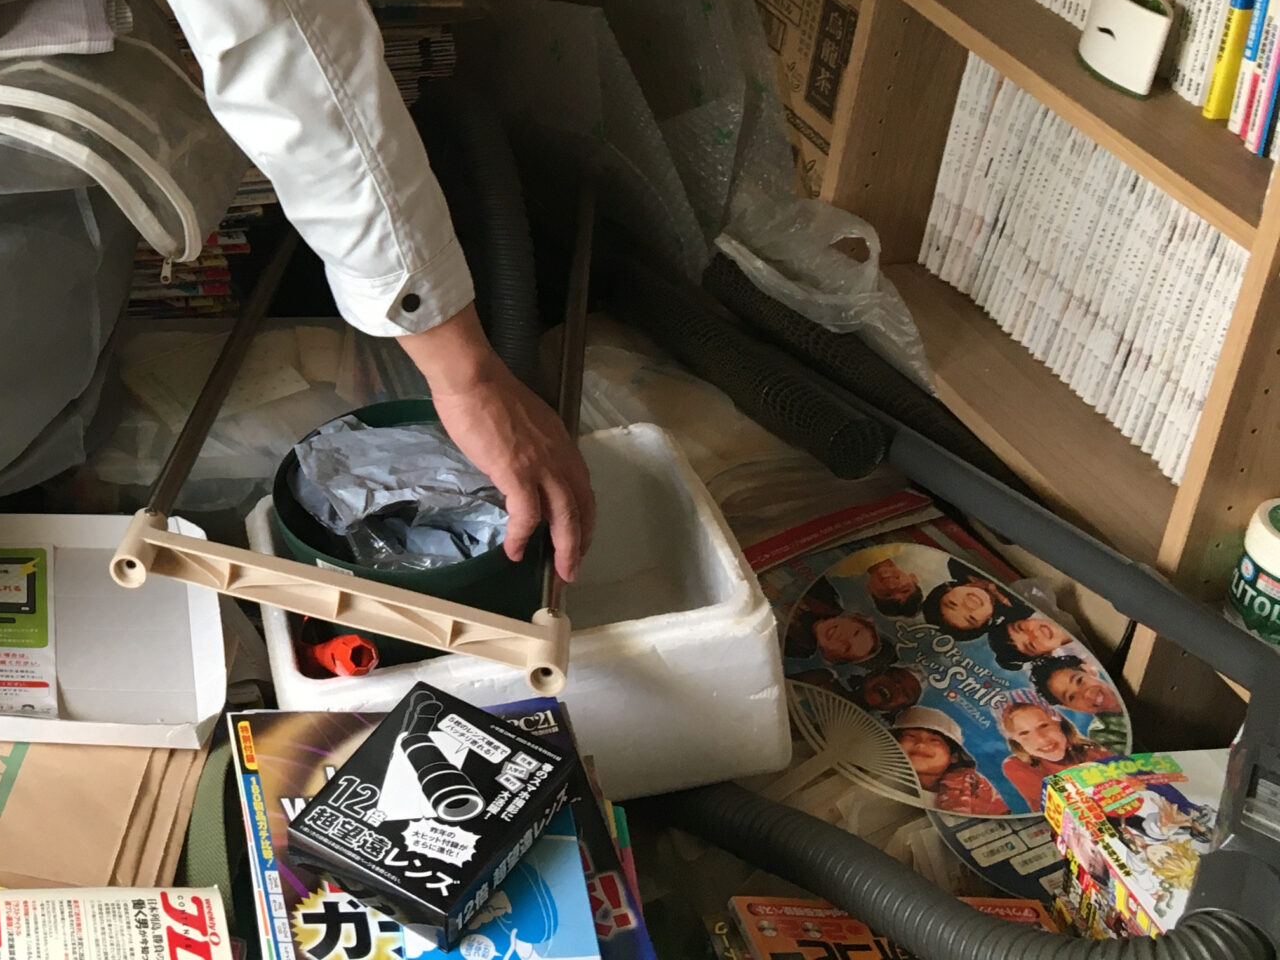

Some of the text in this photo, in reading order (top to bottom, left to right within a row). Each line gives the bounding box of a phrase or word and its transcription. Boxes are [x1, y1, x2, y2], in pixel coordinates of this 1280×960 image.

[813, 12, 845, 96] 烏龍茶
[928, 666, 1009, 709] Smile
[447, 716, 508, 756] 5枚のレンズ構成で
[501, 762, 555, 822] 春のスマホ撮影に
[1081, 756, 1174, 785] 七つの大罪
[329, 775, 388, 830] 12倍
[305, 805, 461, 898] 超望遠レンズ
[411, 831, 468, 853] 大ヒット付録が
[429, 824, 456, 840] 昨年の
[205, 898, 216, 931] weekly
[455, 888, 489, 931] 12倍
